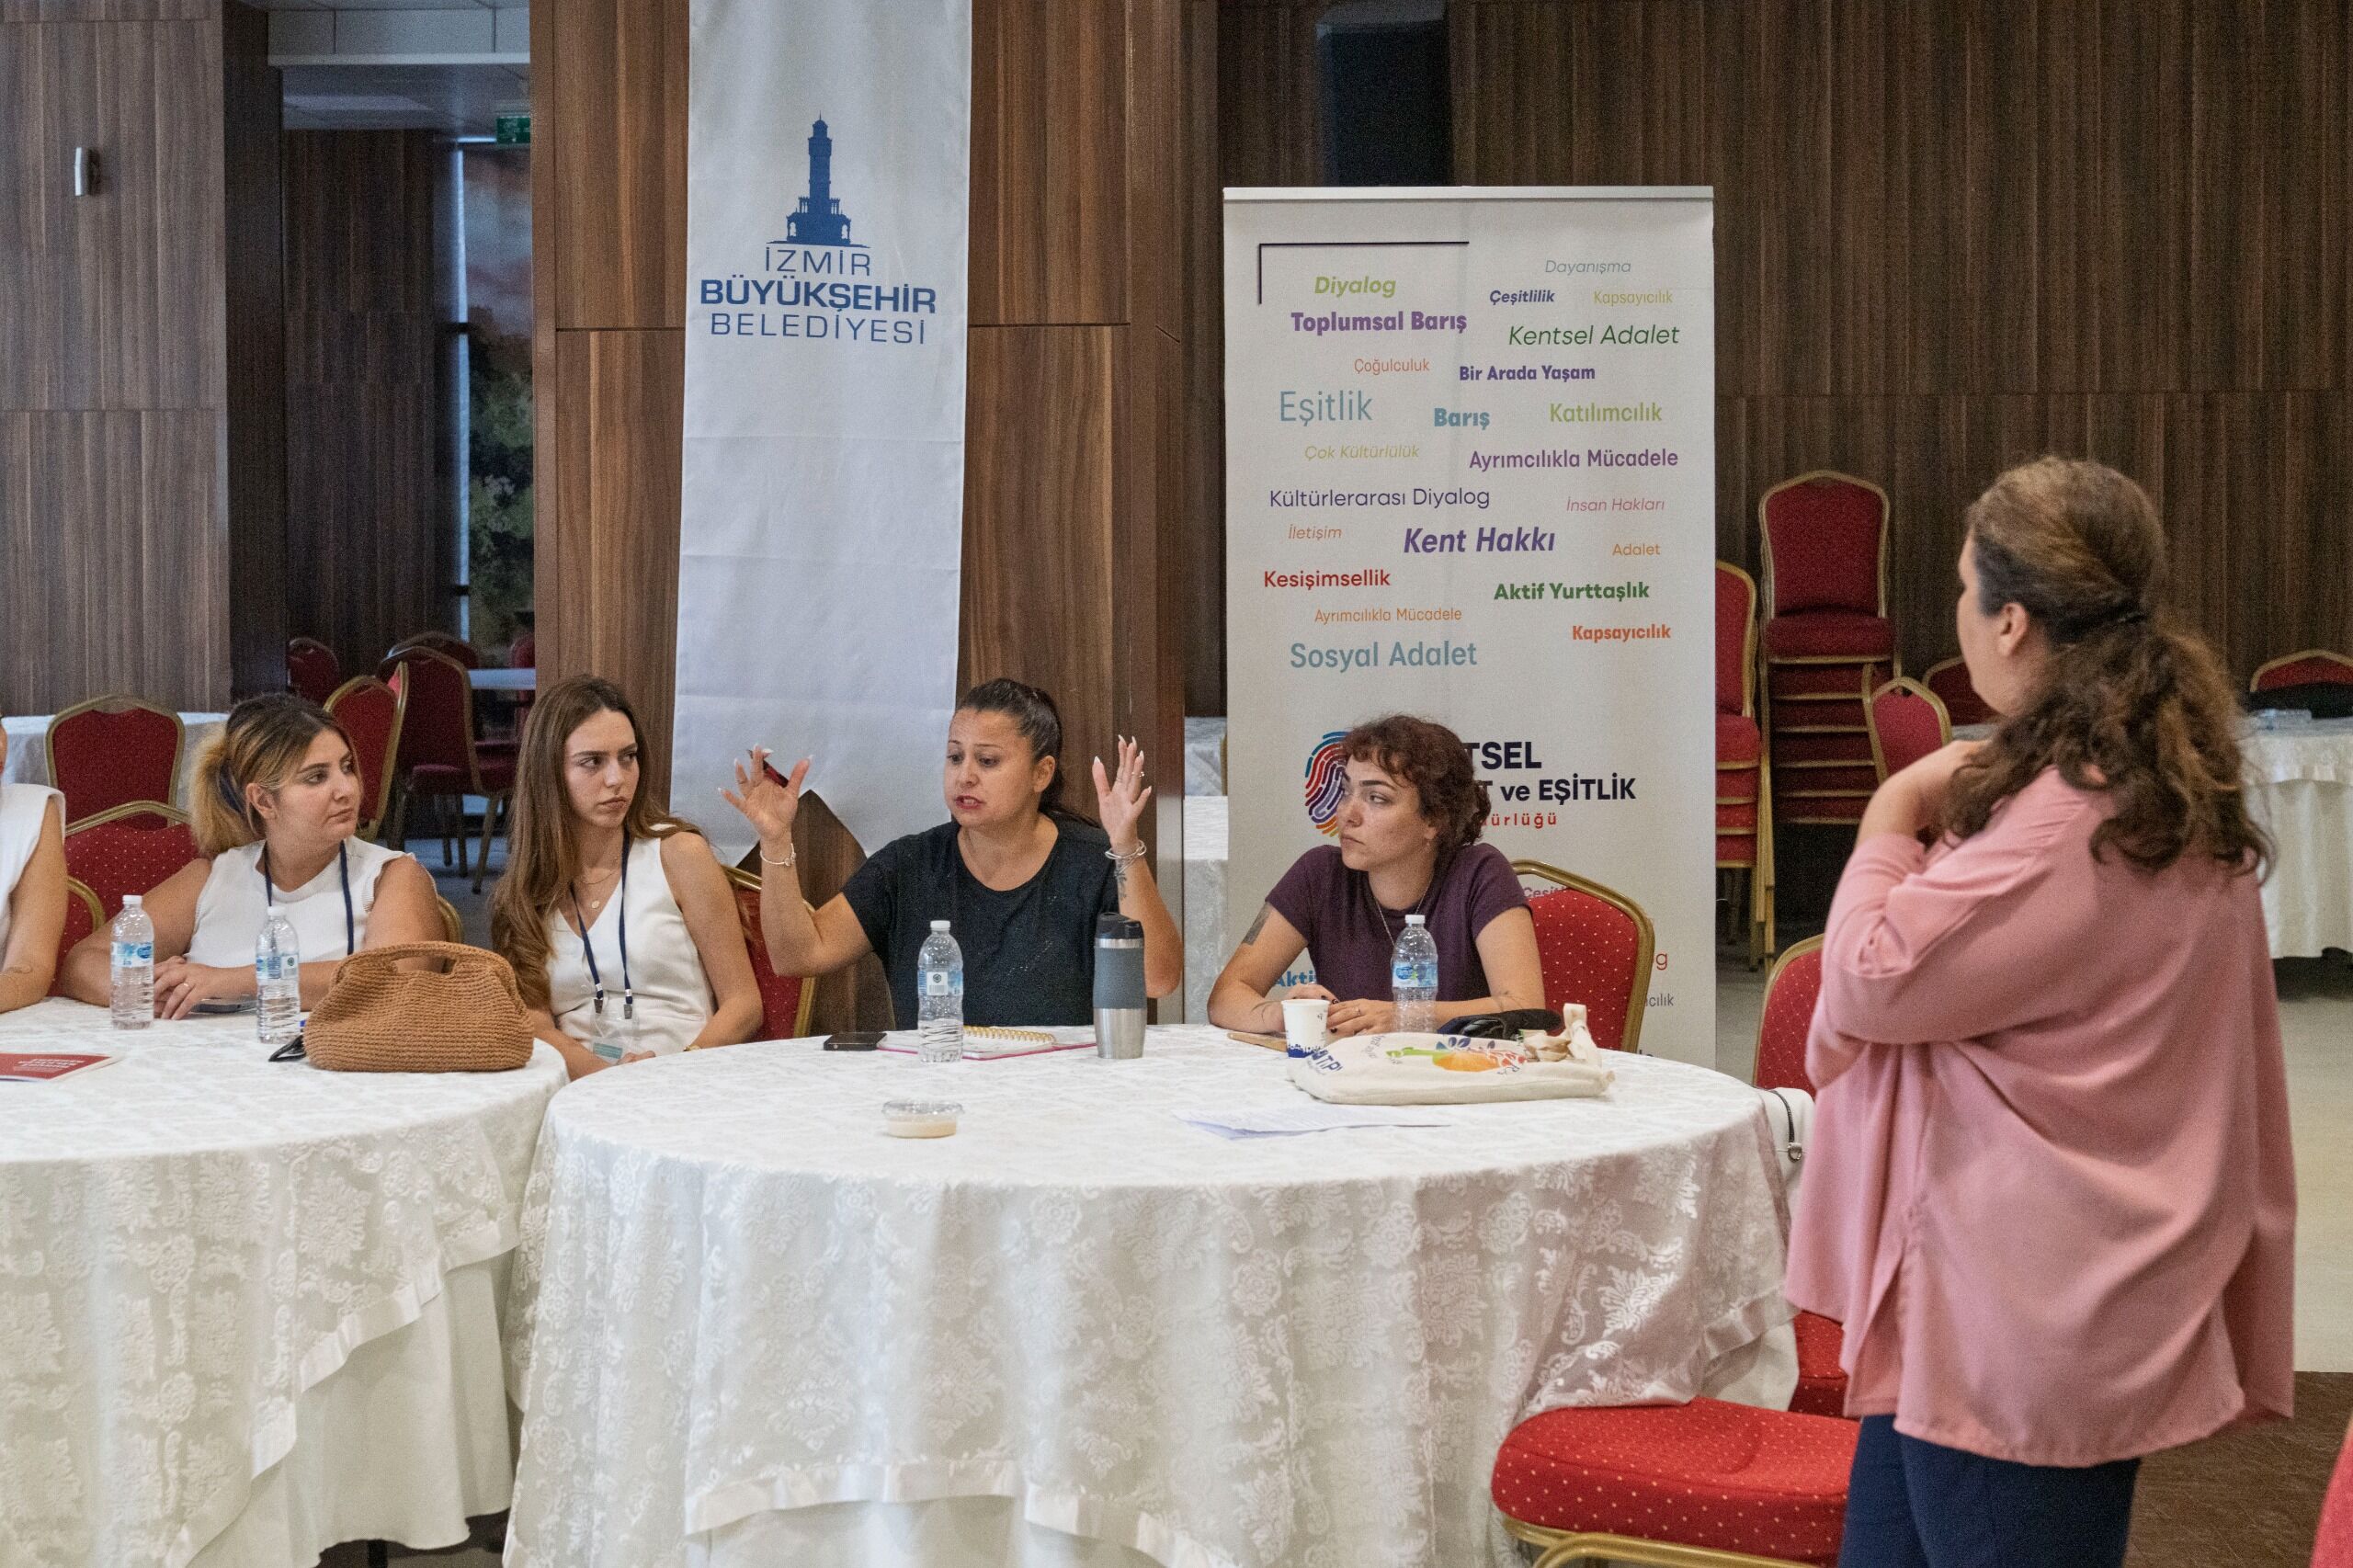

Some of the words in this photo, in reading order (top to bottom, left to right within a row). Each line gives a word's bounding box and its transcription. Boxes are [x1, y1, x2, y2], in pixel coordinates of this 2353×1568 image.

[766, 246, 870, 277] İZMİR
[1544, 259, 1631, 276] Dayanışma
[700, 274, 937, 314] BÜYÜKŞEHİR
[1314, 276, 1396, 299] Diyalog
[1489, 289, 1555, 306] Çeşitlilik
[1592, 290, 1672, 307] Kapsayıcılık
[710, 312, 925, 345] BELEDİYESİ
[1290, 311, 1404, 336] Toplumsal
[1411, 311, 1467, 335] Barış
[1508, 324, 1595, 346] Kentsel
[1599, 324, 1680, 345] Adalet
[1353, 358, 1430, 377] Çoğulculuk
[1459, 365, 1483, 381] Bir
[1486, 365, 1538, 381] Arada
[1541, 365, 1596, 383] Yaşam
[1279, 390, 1372, 427] Eşitlik
[1434, 407, 1490, 431] Barış
[1549, 402, 1663, 423] Katılımcılık
[1469, 449, 1581, 472] Ayrımcılıkla
[1587, 448, 1678, 468] Mücadele
[1269, 489, 1406, 507] Kültürlerarası
[1413, 487, 1490, 510] Diyalog
[1565, 495, 1608, 512] İnsan
[1611, 497, 1665, 512] Hakları
[1288, 524, 1343, 541] İletişim
[1404, 528, 1467, 553] Kent
[1475, 526, 1555, 552] Hakkı
[1611, 543, 1661, 557] Adalet
[1264, 568, 1391, 591] Kesişimsellik
[1494, 582, 1545, 600] Aktif
[1549, 581, 1650, 603] Yurttaşlık
[1313, 608, 1392, 626] Ayrımcılıkla
[1396, 607, 1462, 621] Mücadele
[1572, 623, 1671, 643] Kapsayıcılık
[1290, 641, 1379, 674] Sosyal
[1388, 640, 1478, 666] Adalet
[1464, 742, 1542, 770] TSEL
[1500, 785, 1530, 801] ve
[1539, 772, 1636, 805] EŞİTLİK
[1483, 812, 1557, 830] ürlüğü
